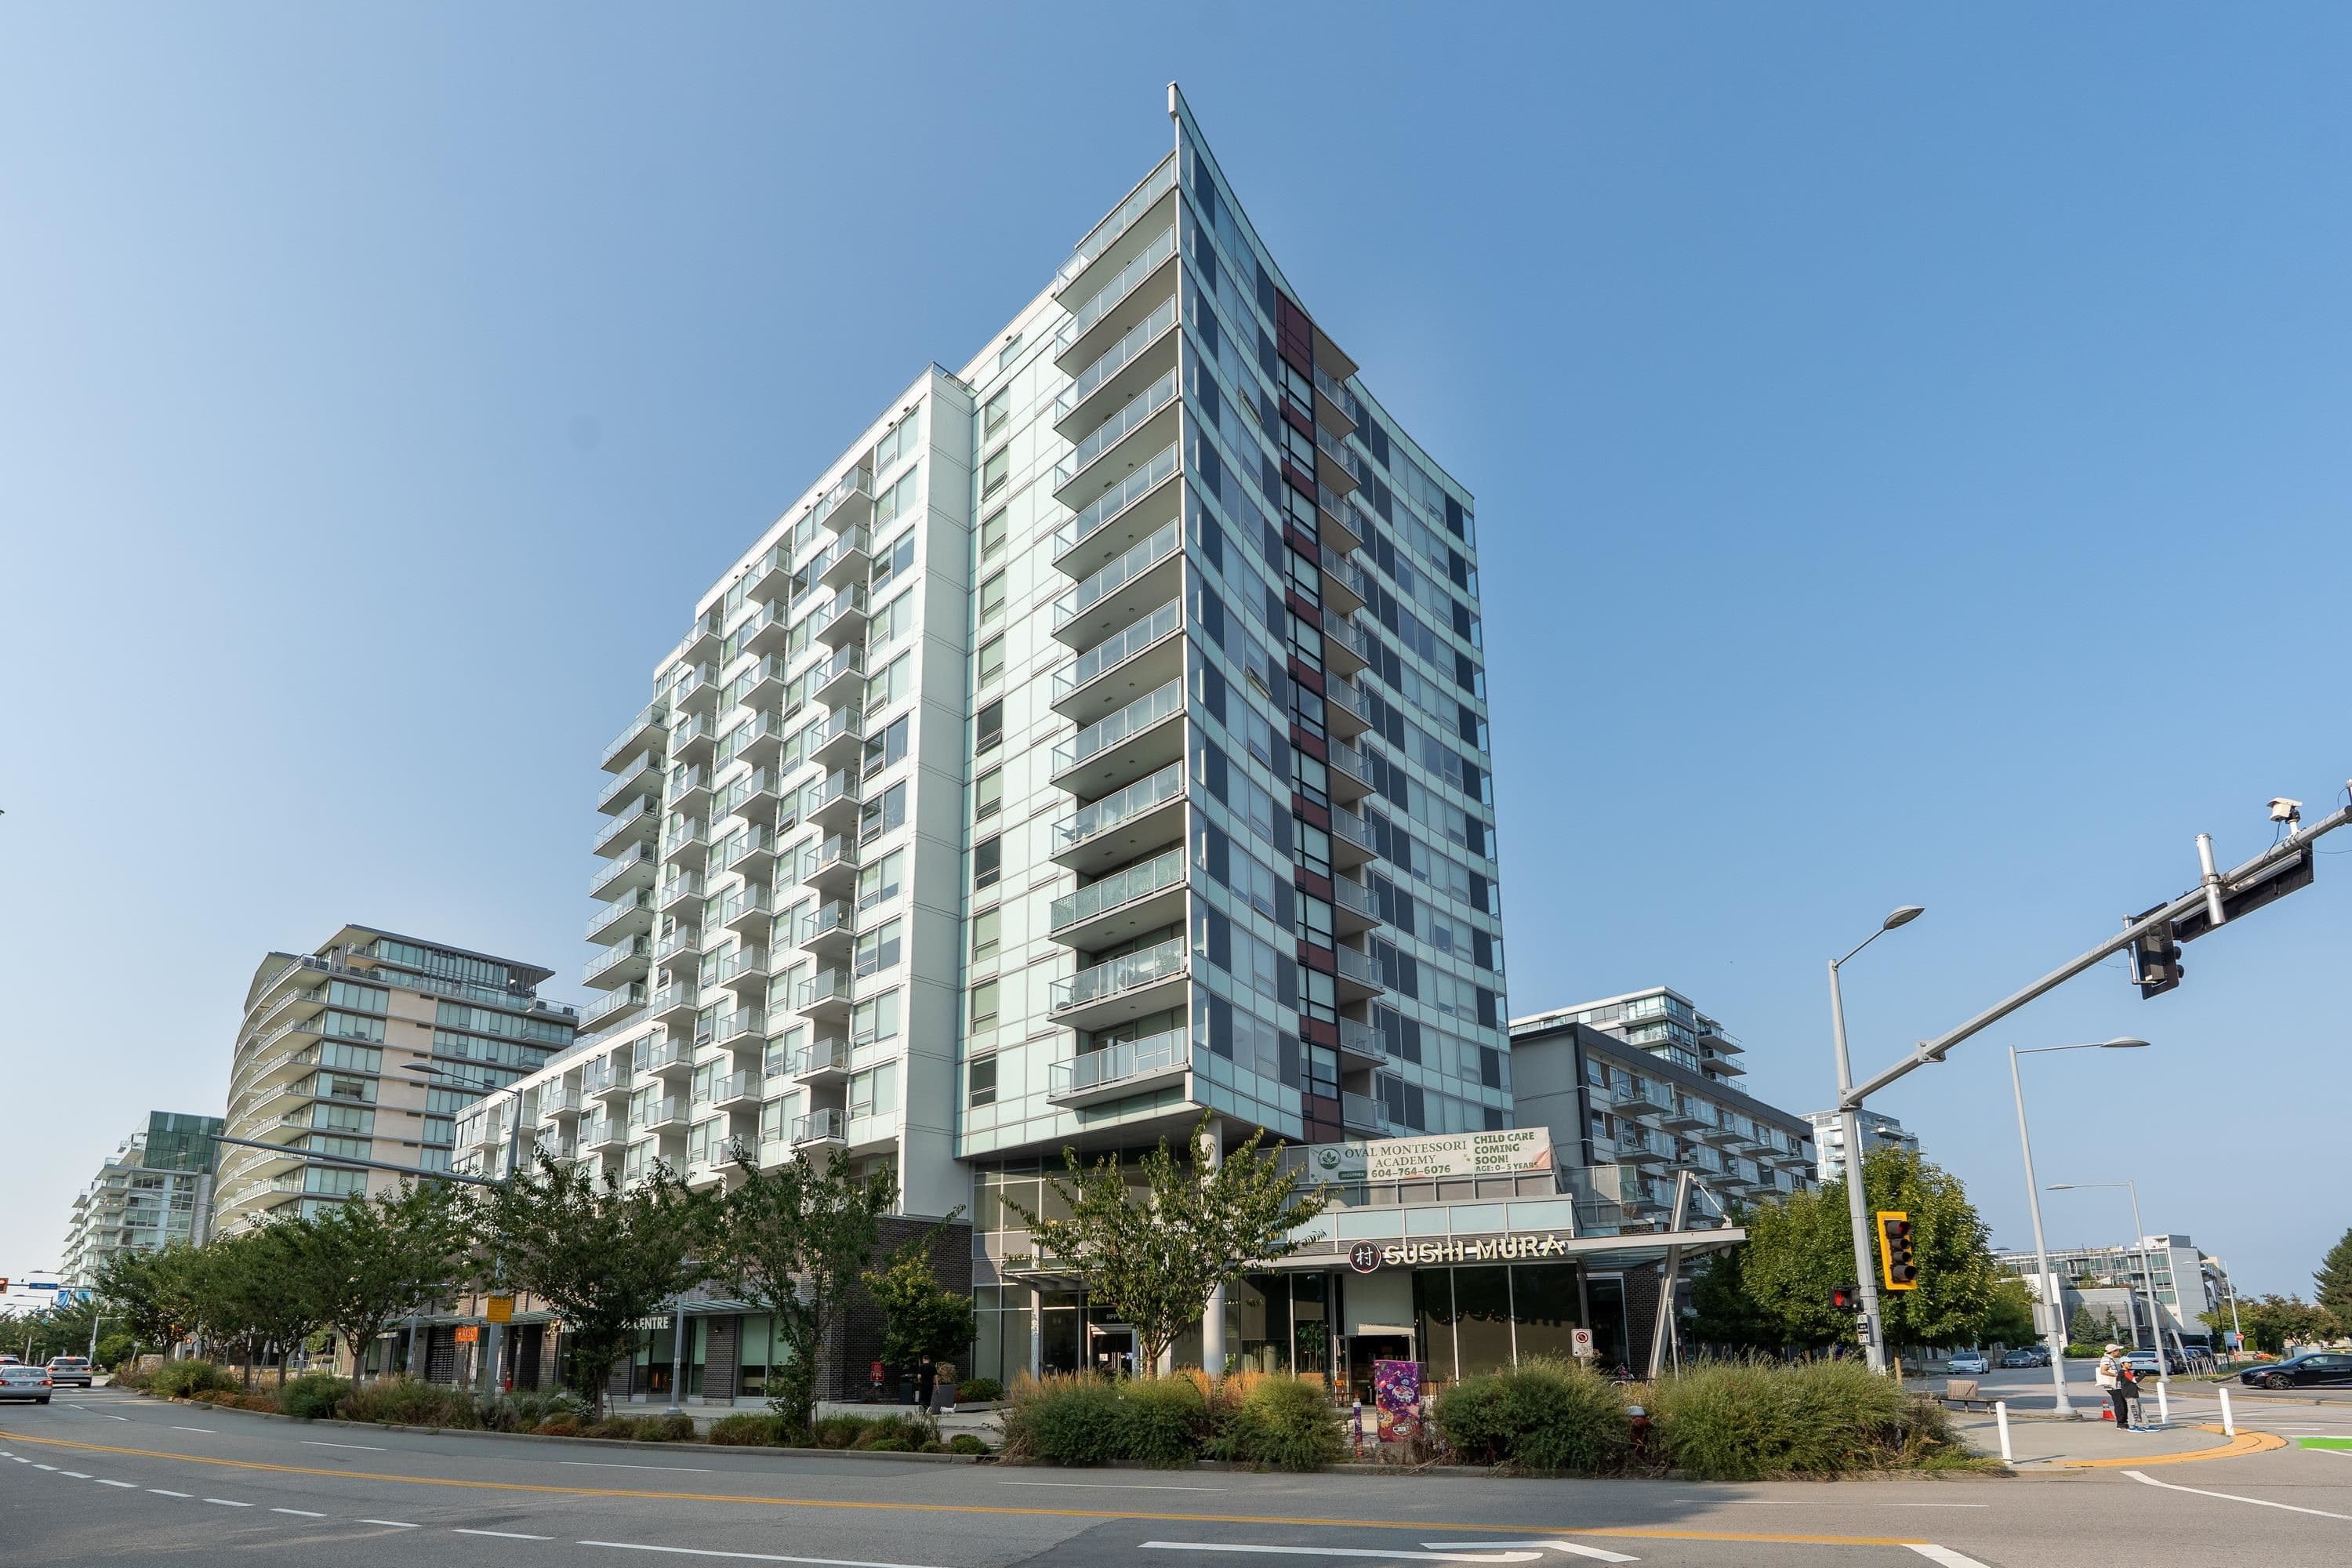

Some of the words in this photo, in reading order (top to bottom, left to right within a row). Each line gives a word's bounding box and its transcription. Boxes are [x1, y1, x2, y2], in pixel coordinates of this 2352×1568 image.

[1474, 1134, 1504, 1144] CHILD
[1507, 1132, 1534, 1142] CARE
[1345, 1148, 1377, 1159] OVAL
[1381, 1141, 1467, 1156] MONTESSORI
[1475, 1144, 1519, 1154] COMING
[1375, 1155, 1436, 1167] ACADEMY
[1475, 1155, 1508, 1165] SOON!
[1371, 1165, 1450, 1178] 604-764-6076
[1385, 1240, 1464, 1265] SUSHI
[1475, 1234, 1565, 1261] MURA
[1356, 1247, 1374, 1266] 村
